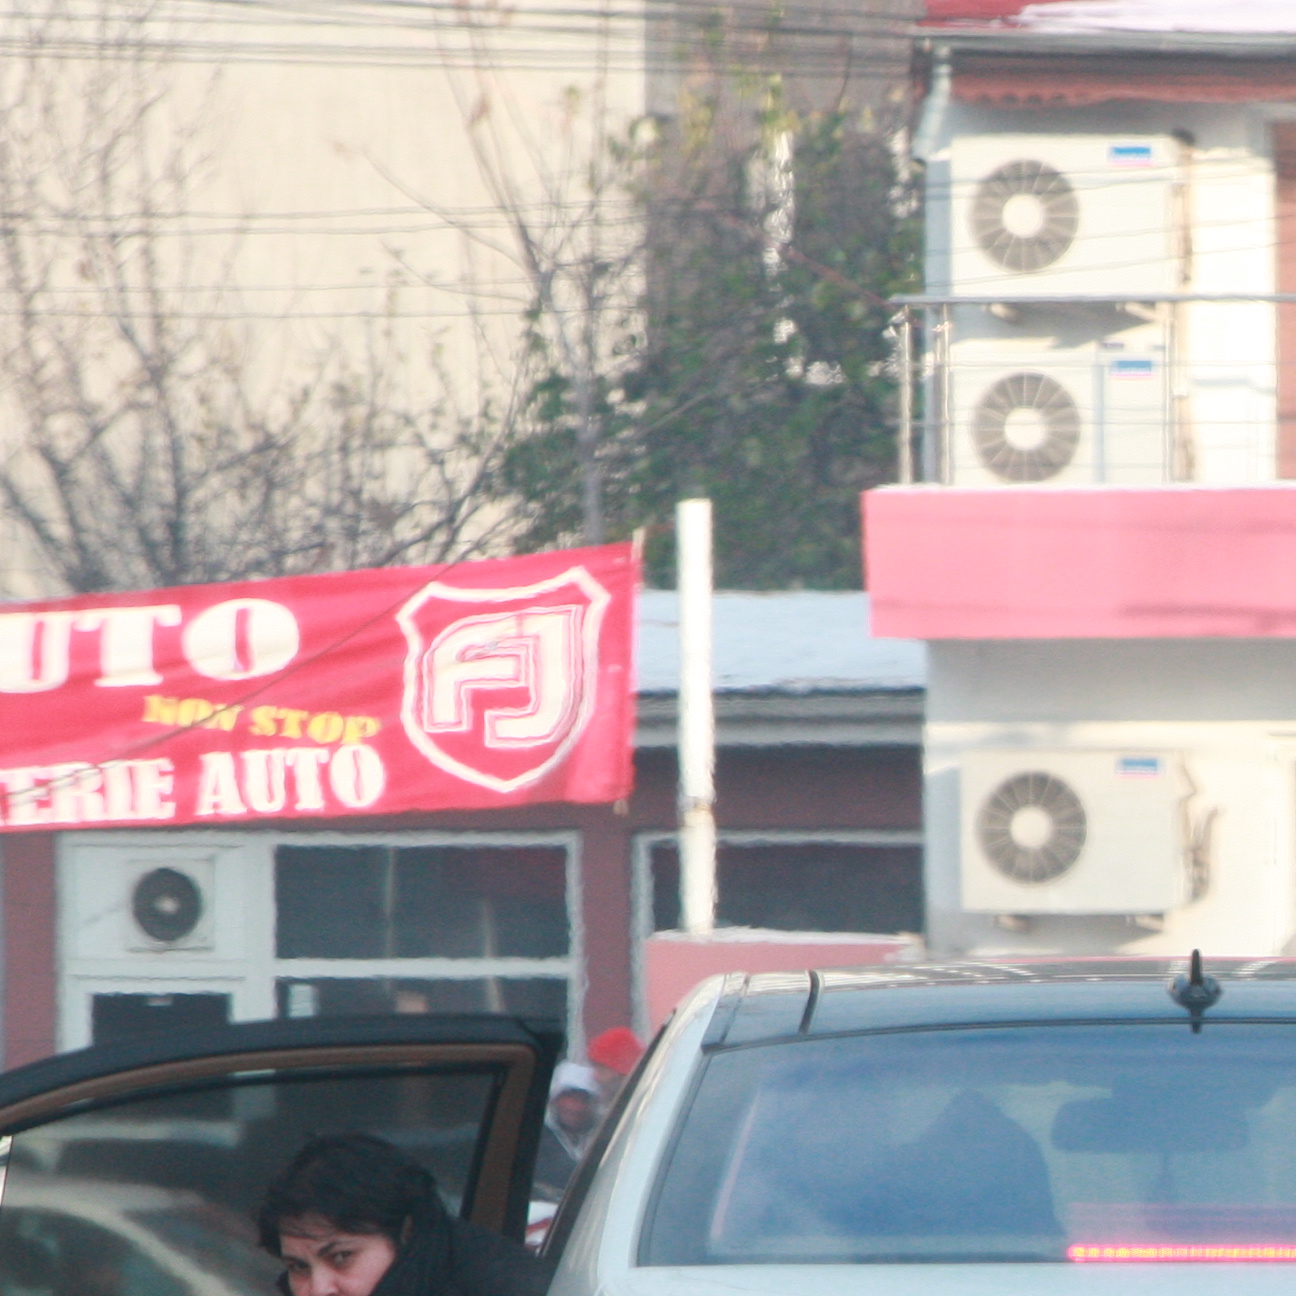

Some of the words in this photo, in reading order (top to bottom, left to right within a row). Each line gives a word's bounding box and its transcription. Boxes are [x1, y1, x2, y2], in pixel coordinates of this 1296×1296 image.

[141, 695, 244, 731] NON
[249, 706, 381, 744] STOP
[0, 758, 176, 826] ERIE
[195, 744, 386, 816] AUTO
